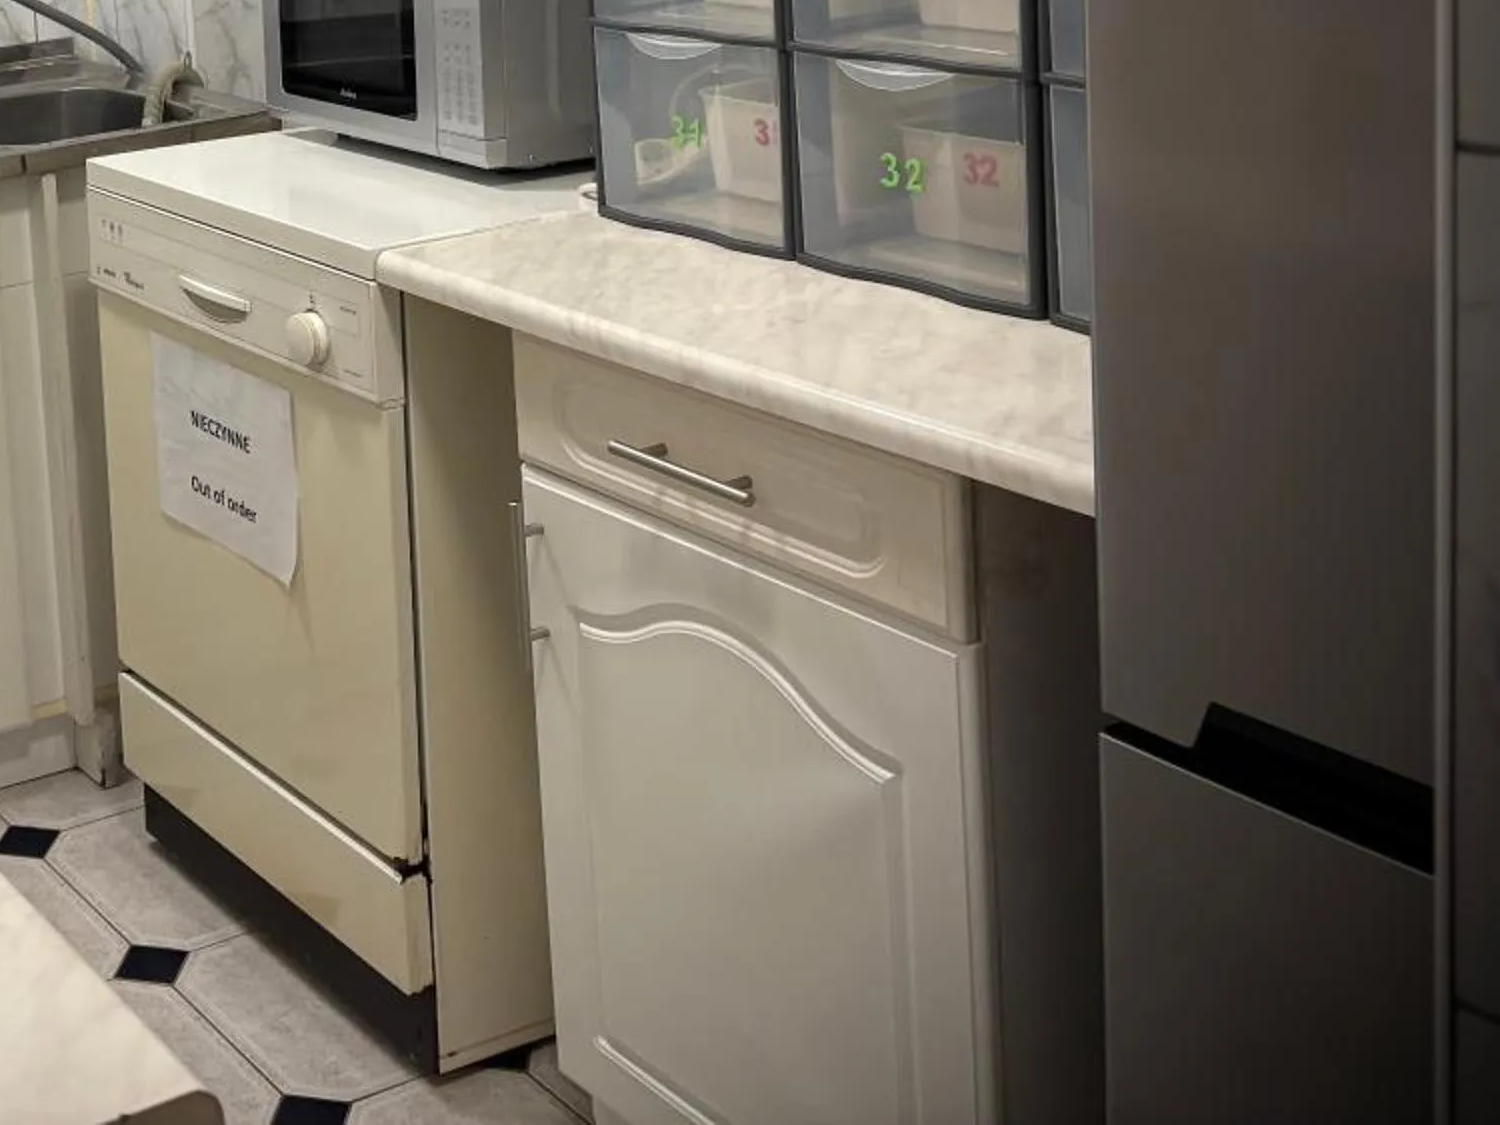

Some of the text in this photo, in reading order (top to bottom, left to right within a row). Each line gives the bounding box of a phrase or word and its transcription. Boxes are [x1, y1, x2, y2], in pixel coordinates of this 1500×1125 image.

[879, 151, 928, 195] 32
[961, 152, 999, 188] 32
[191, 475, 257, 524] Out of order
